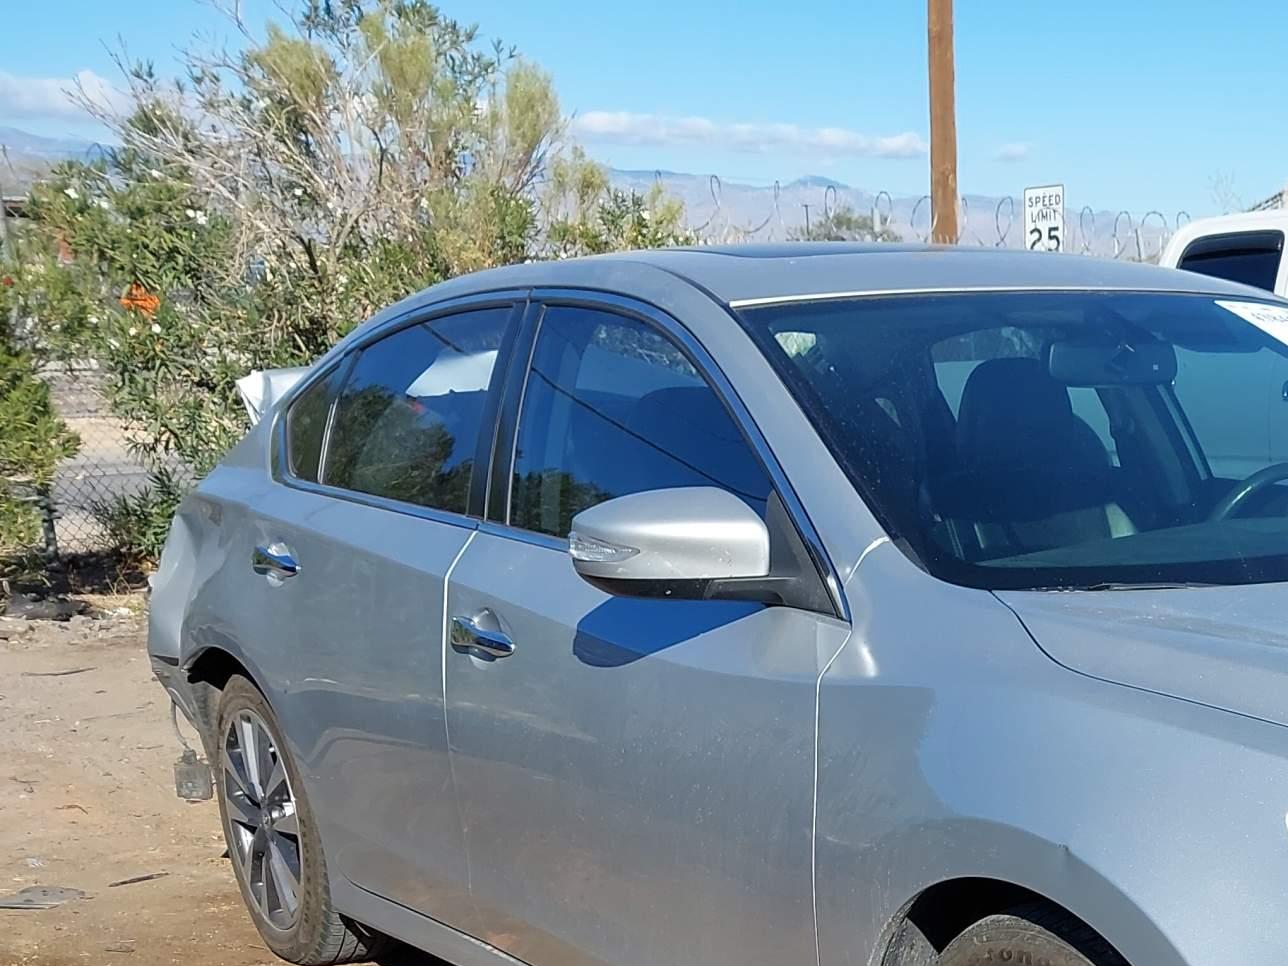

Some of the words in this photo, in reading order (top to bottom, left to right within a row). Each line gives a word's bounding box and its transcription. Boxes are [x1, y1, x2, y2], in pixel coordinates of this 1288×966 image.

[1028, 194, 1061, 208] SPEED
[1031, 208, 1057, 223] LIMIT
[1030, 226, 1060, 252] 25
